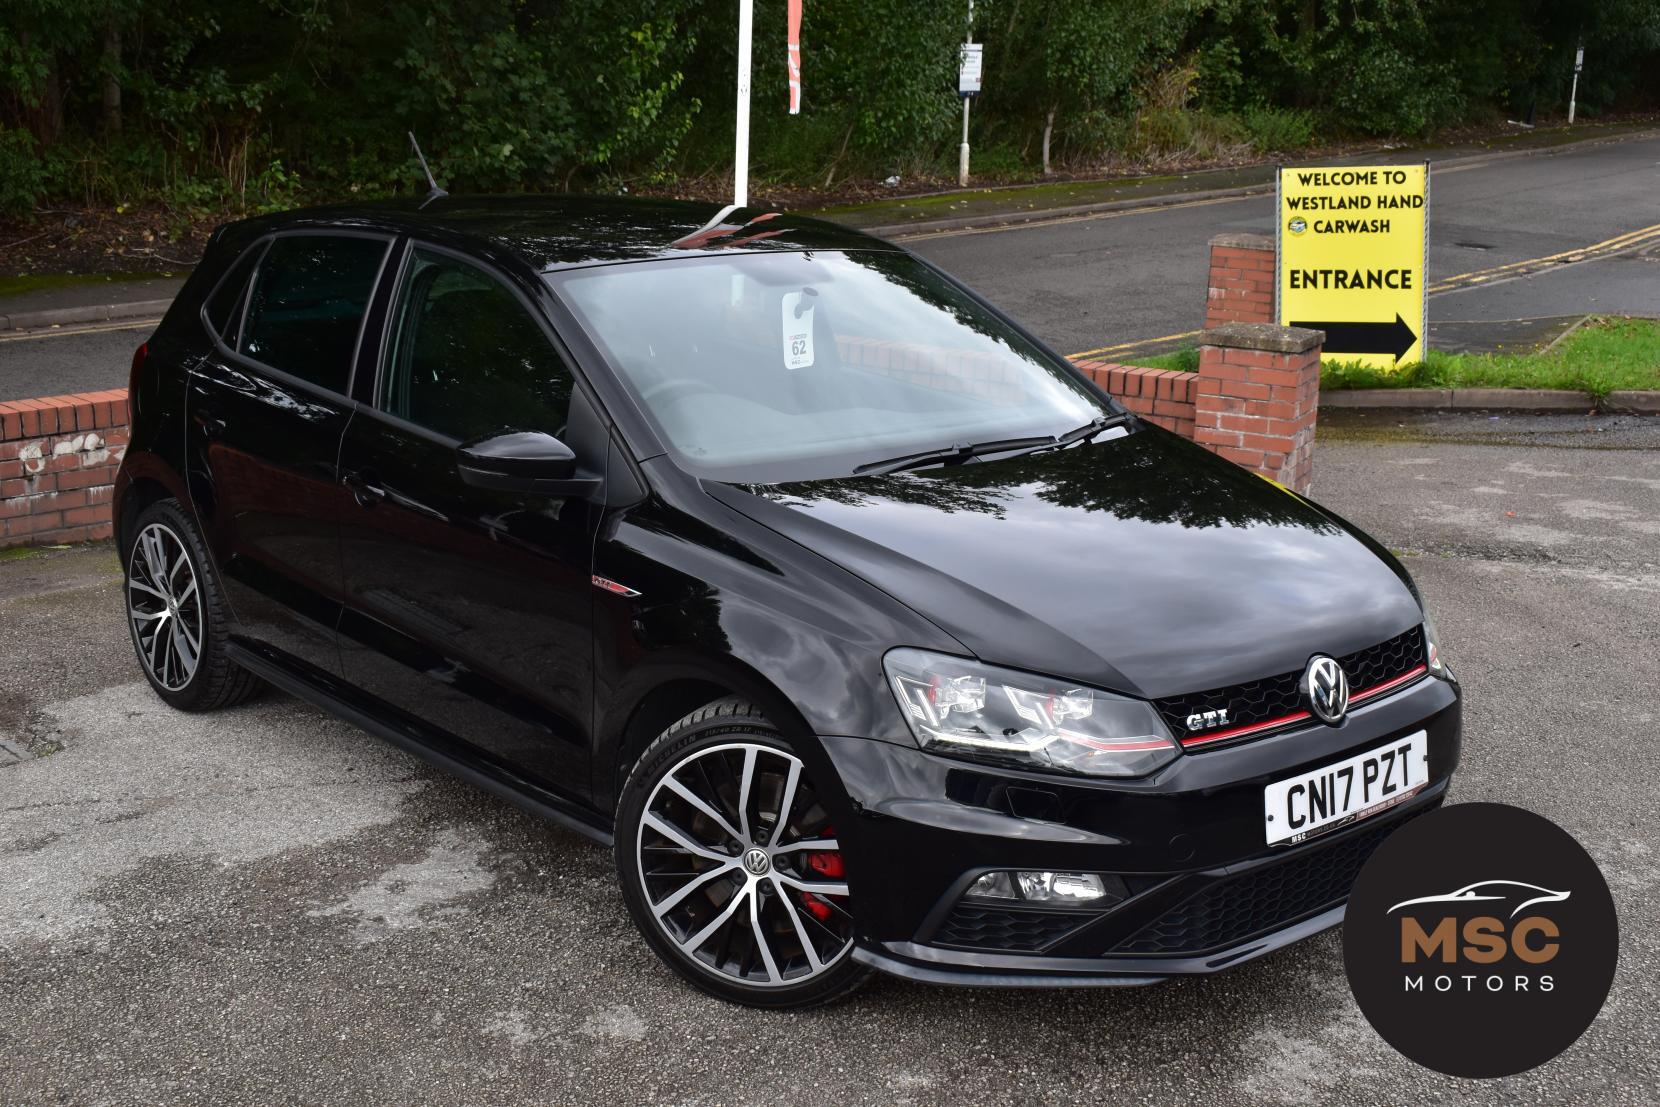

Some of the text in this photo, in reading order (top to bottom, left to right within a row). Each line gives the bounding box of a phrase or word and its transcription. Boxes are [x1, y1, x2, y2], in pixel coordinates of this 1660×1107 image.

[1297, 170, 1407, 186] WELCOME TO
[1286, 195, 1424, 210] WESTLAND HAND
[1313, 219, 1390, 234] CARWASH
[1290, 269, 1412, 290] ENTRANCE
[791, 339, 807, 356] 62
[1186, 708, 1230, 731] GTI
[1287, 766, 1354, 830] CN17
[1363, 743, 1412, 803] PZT
[1291, 832, 1306, 844] MSC
